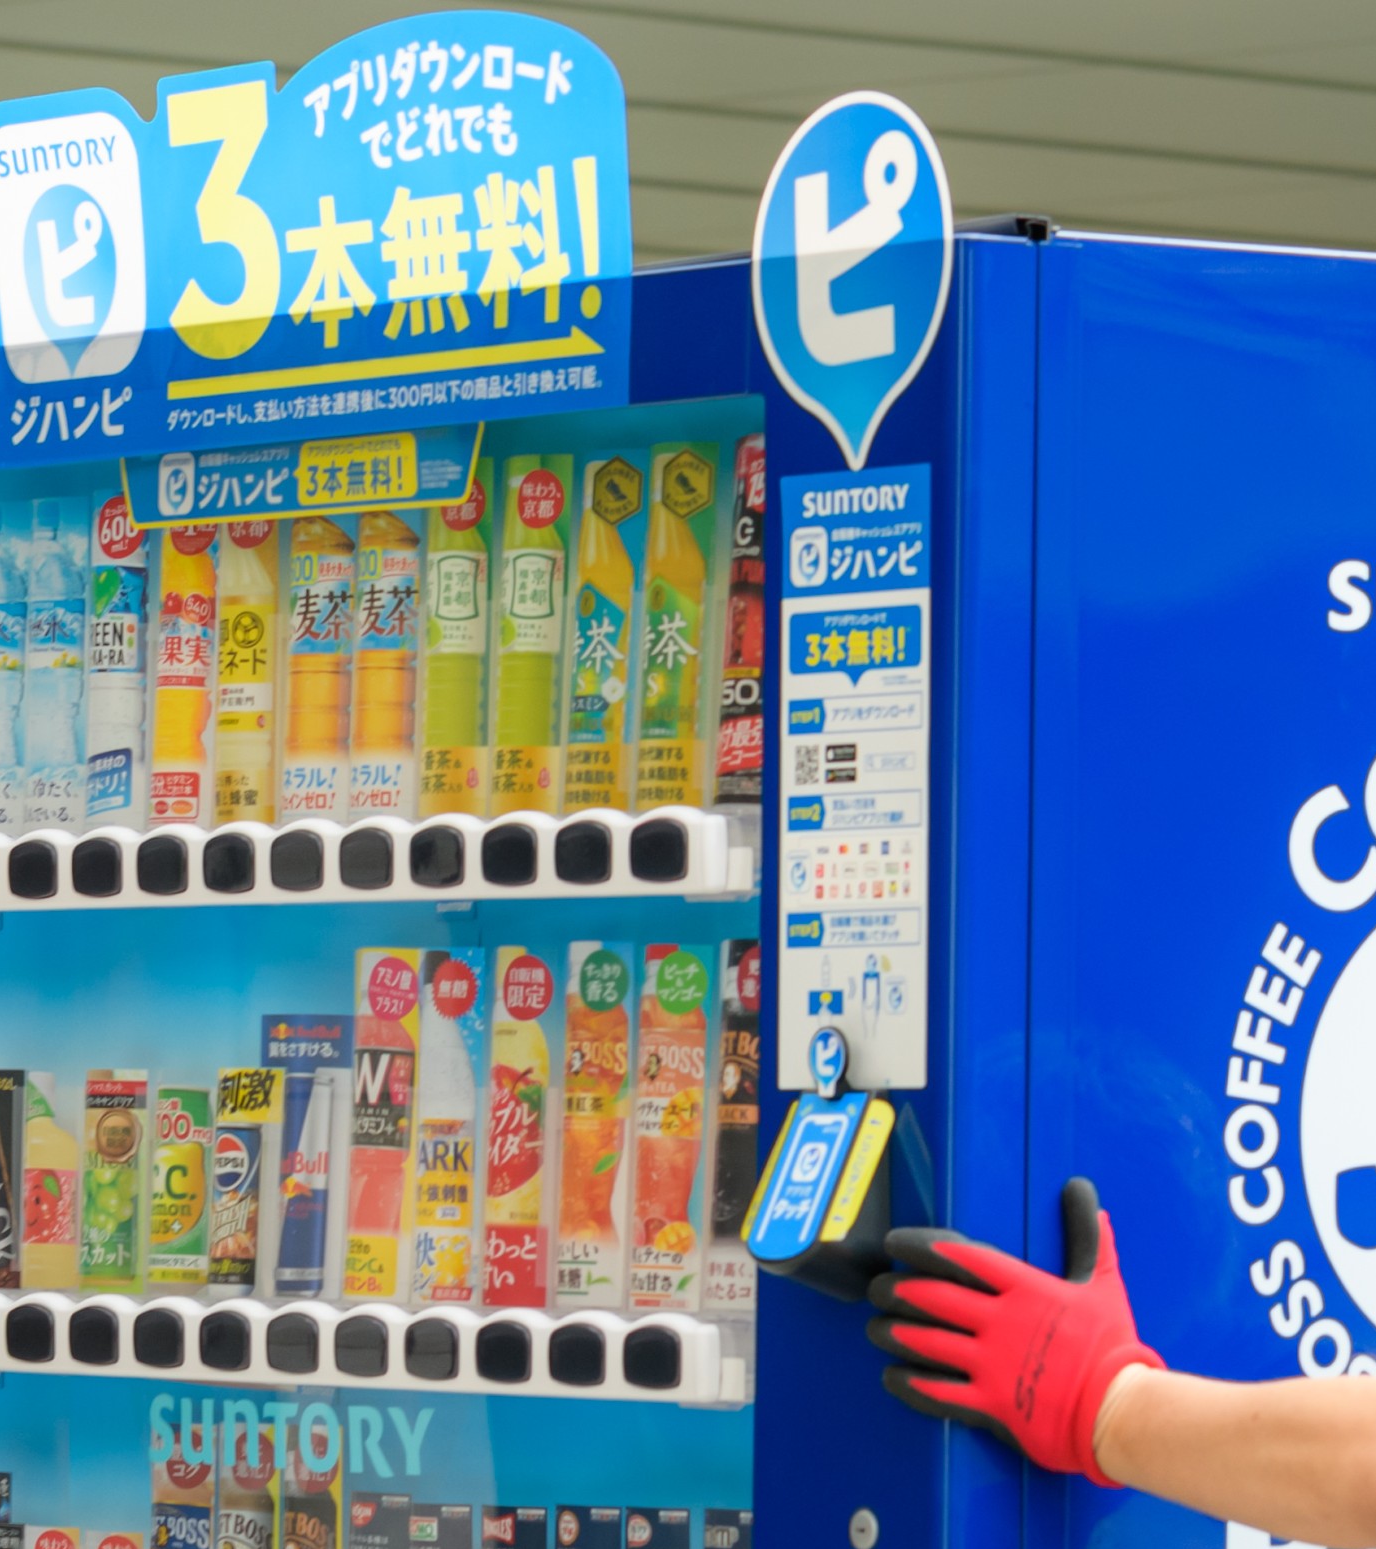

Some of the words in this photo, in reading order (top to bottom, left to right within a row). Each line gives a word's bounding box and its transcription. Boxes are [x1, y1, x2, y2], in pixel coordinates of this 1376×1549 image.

[303, 40, 572, 137] アプリダウンロード
[361, 102, 518, 170] でどれでも
[167, 79, 603, 361] 3本無料!
[9, 386, 133, 445] ジハンピ
[197, 468, 292, 509] ジハンピ
[305, 456, 405, 496] 3本無料!
[522, 498, 555, 519] 京都
[801, 483, 910, 519] SUNTORY
[830, 540, 923, 581] ジハンピ
[294, 588, 355, 642] 麦茶
[360, 583, 420, 638] 麦茶
[805, 626, 906, 667] 3本無料!
[437, 979, 470, 1000] 無糖
[509, 967, 546, 985] 自販機
[585, 961, 623, 980] すっきり
[663, 962, 700, 980] ピーチ
[375, 995, 405, 1014] プラス!
[507, 986, 546, 1010] 限定
[585, 980, 619, 1003] 香る
[657, 985, 703, 1003] マンゴー
[1223, 922, 1323, 1226] COFFEE
[149, 1391, 435, 1479] SUNTORY
